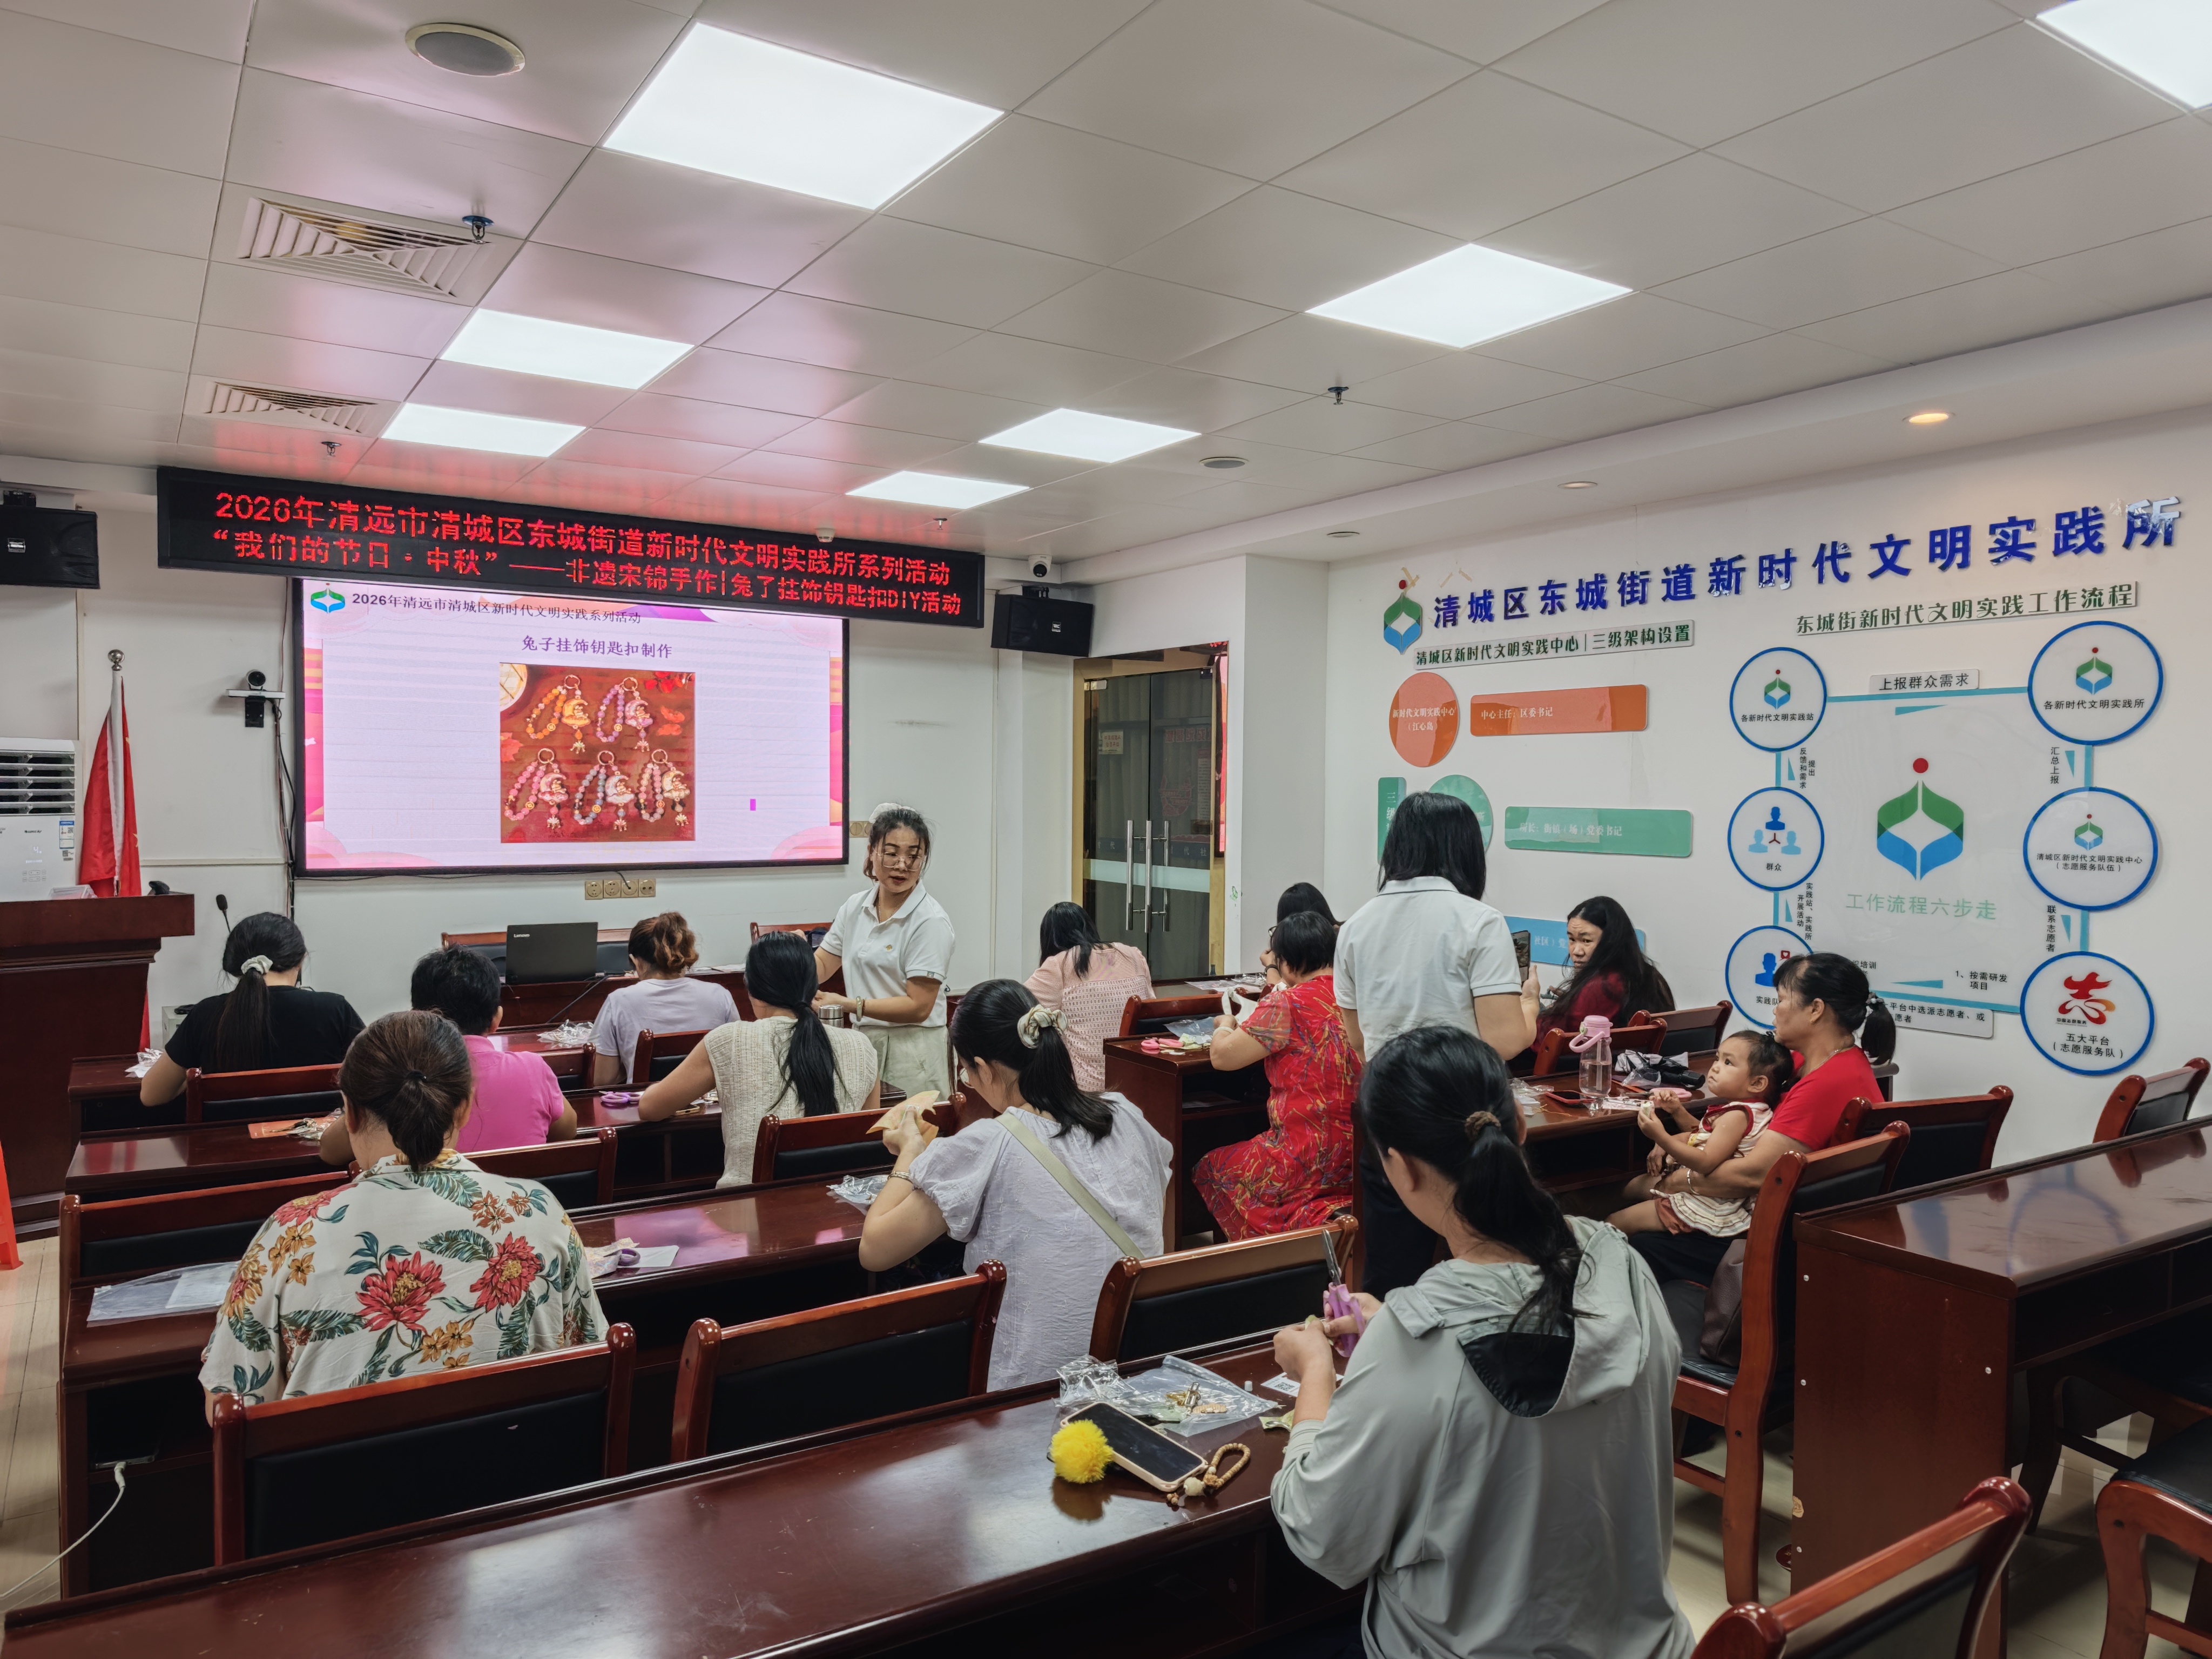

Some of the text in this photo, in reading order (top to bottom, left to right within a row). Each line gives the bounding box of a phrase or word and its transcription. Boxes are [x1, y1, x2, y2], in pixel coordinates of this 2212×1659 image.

[215, 491, 950, 586] 2026年清远市清城区东城街道新时代文明实践所系列活动
[1434, 496, 2183, 629] 清城区东城街道新时代文明实践所
[352, 593, 642, 624] 2026年清远市清城区新时代文明实践系列活动
[1796, 583, 2133, 634] 东城街新时代文明实践工作流程
[522, 635, 672, 659] 兔子挂饰钥匙扣制作
[1879, 673, 1970, 692] 上报群众需求
[2044, 699, 2145, 710] 各新时代文明实践所
[1741, 713, 1815, 723] 各新时代文明实践站
[1808, 760, 1816, 776] 提出
[2050, 747, 2060, 784] 汇总上报
[1766, 863, 1782, 871] 群众
[2036, 853, 2143, 864] 清城区新时代文明实践中心
[1846, 894, 1997, 920] 工作流程六步走
[2046, 905, 2056, 952] 联系志愿者
[1955, 970, 2008, 983] 1、按需研发
[1970, 981, 1988, 990] 项目
[1885, 1003, 1985, 1021] 平台中选派志愿者、或
[1893, 1013, 1912, 1023] 愿者
[2066, 1033, 2109, 1046] 五大平台
